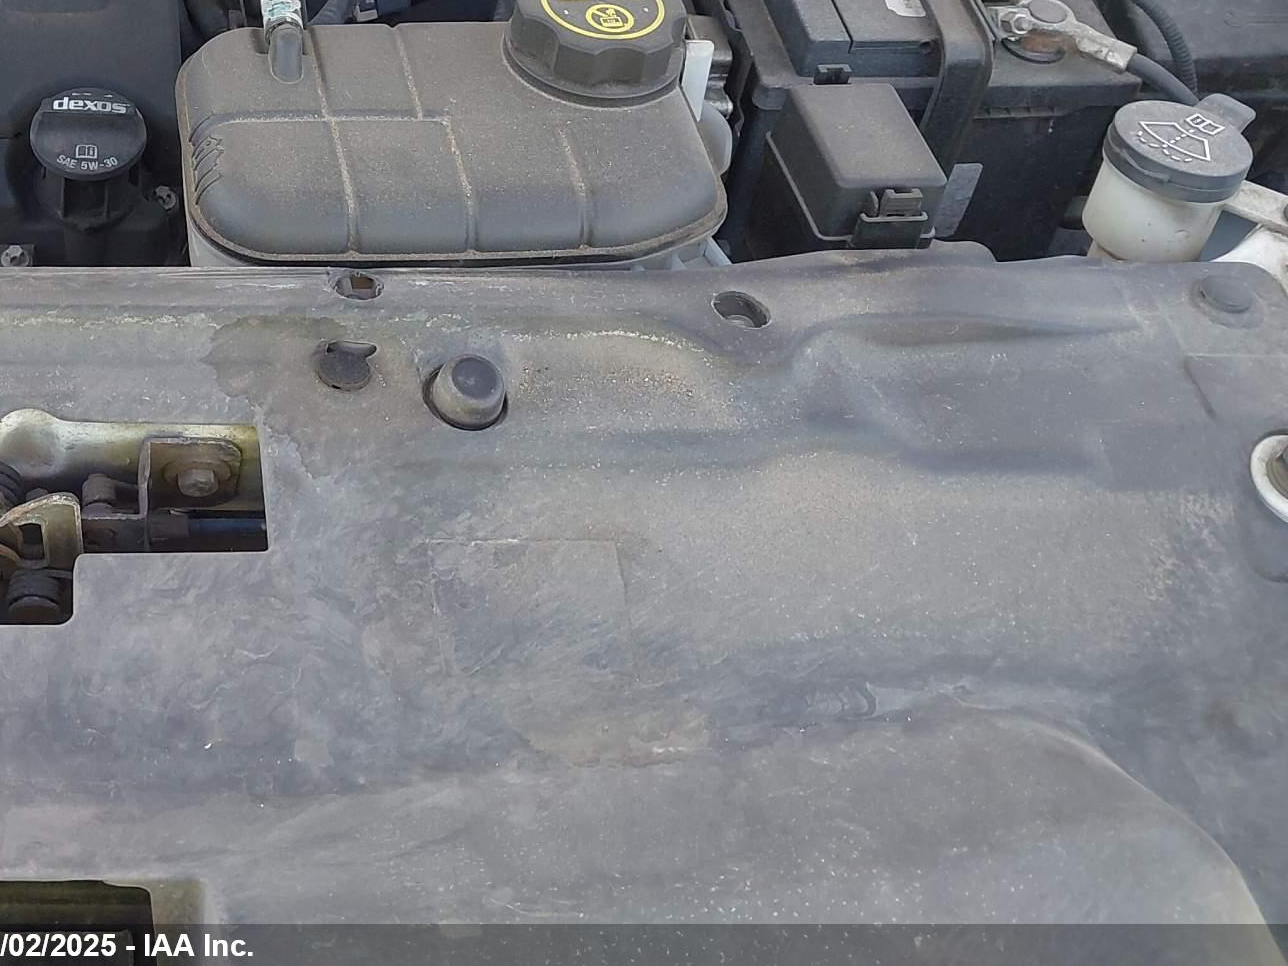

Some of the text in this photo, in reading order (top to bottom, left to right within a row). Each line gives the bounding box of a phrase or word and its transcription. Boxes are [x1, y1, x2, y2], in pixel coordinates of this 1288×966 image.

[52, 96, 128, 114] dexos
[56, 154, 118, 170] SAE 5W-30
